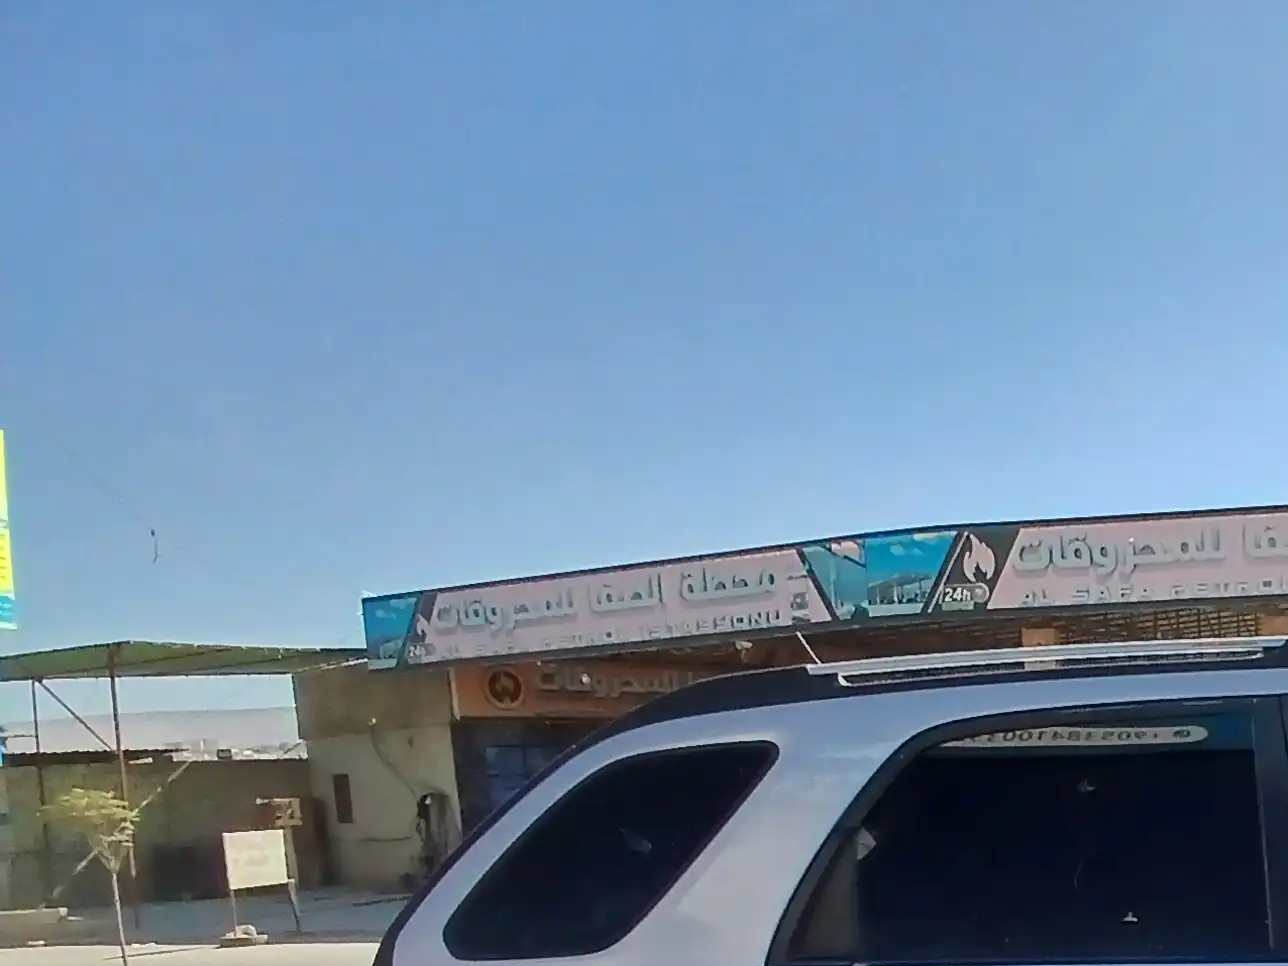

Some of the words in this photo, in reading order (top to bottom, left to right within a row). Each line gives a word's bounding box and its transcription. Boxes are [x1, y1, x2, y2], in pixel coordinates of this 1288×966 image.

[1012, 526, 1227, 578] للمحروقات
[588, 571, 665, 614] الصفا
[680, 566, 778, 604] محطة
[944, 586, 971, 602] 24h
[435, 586, 578, 636] للمحروقات
